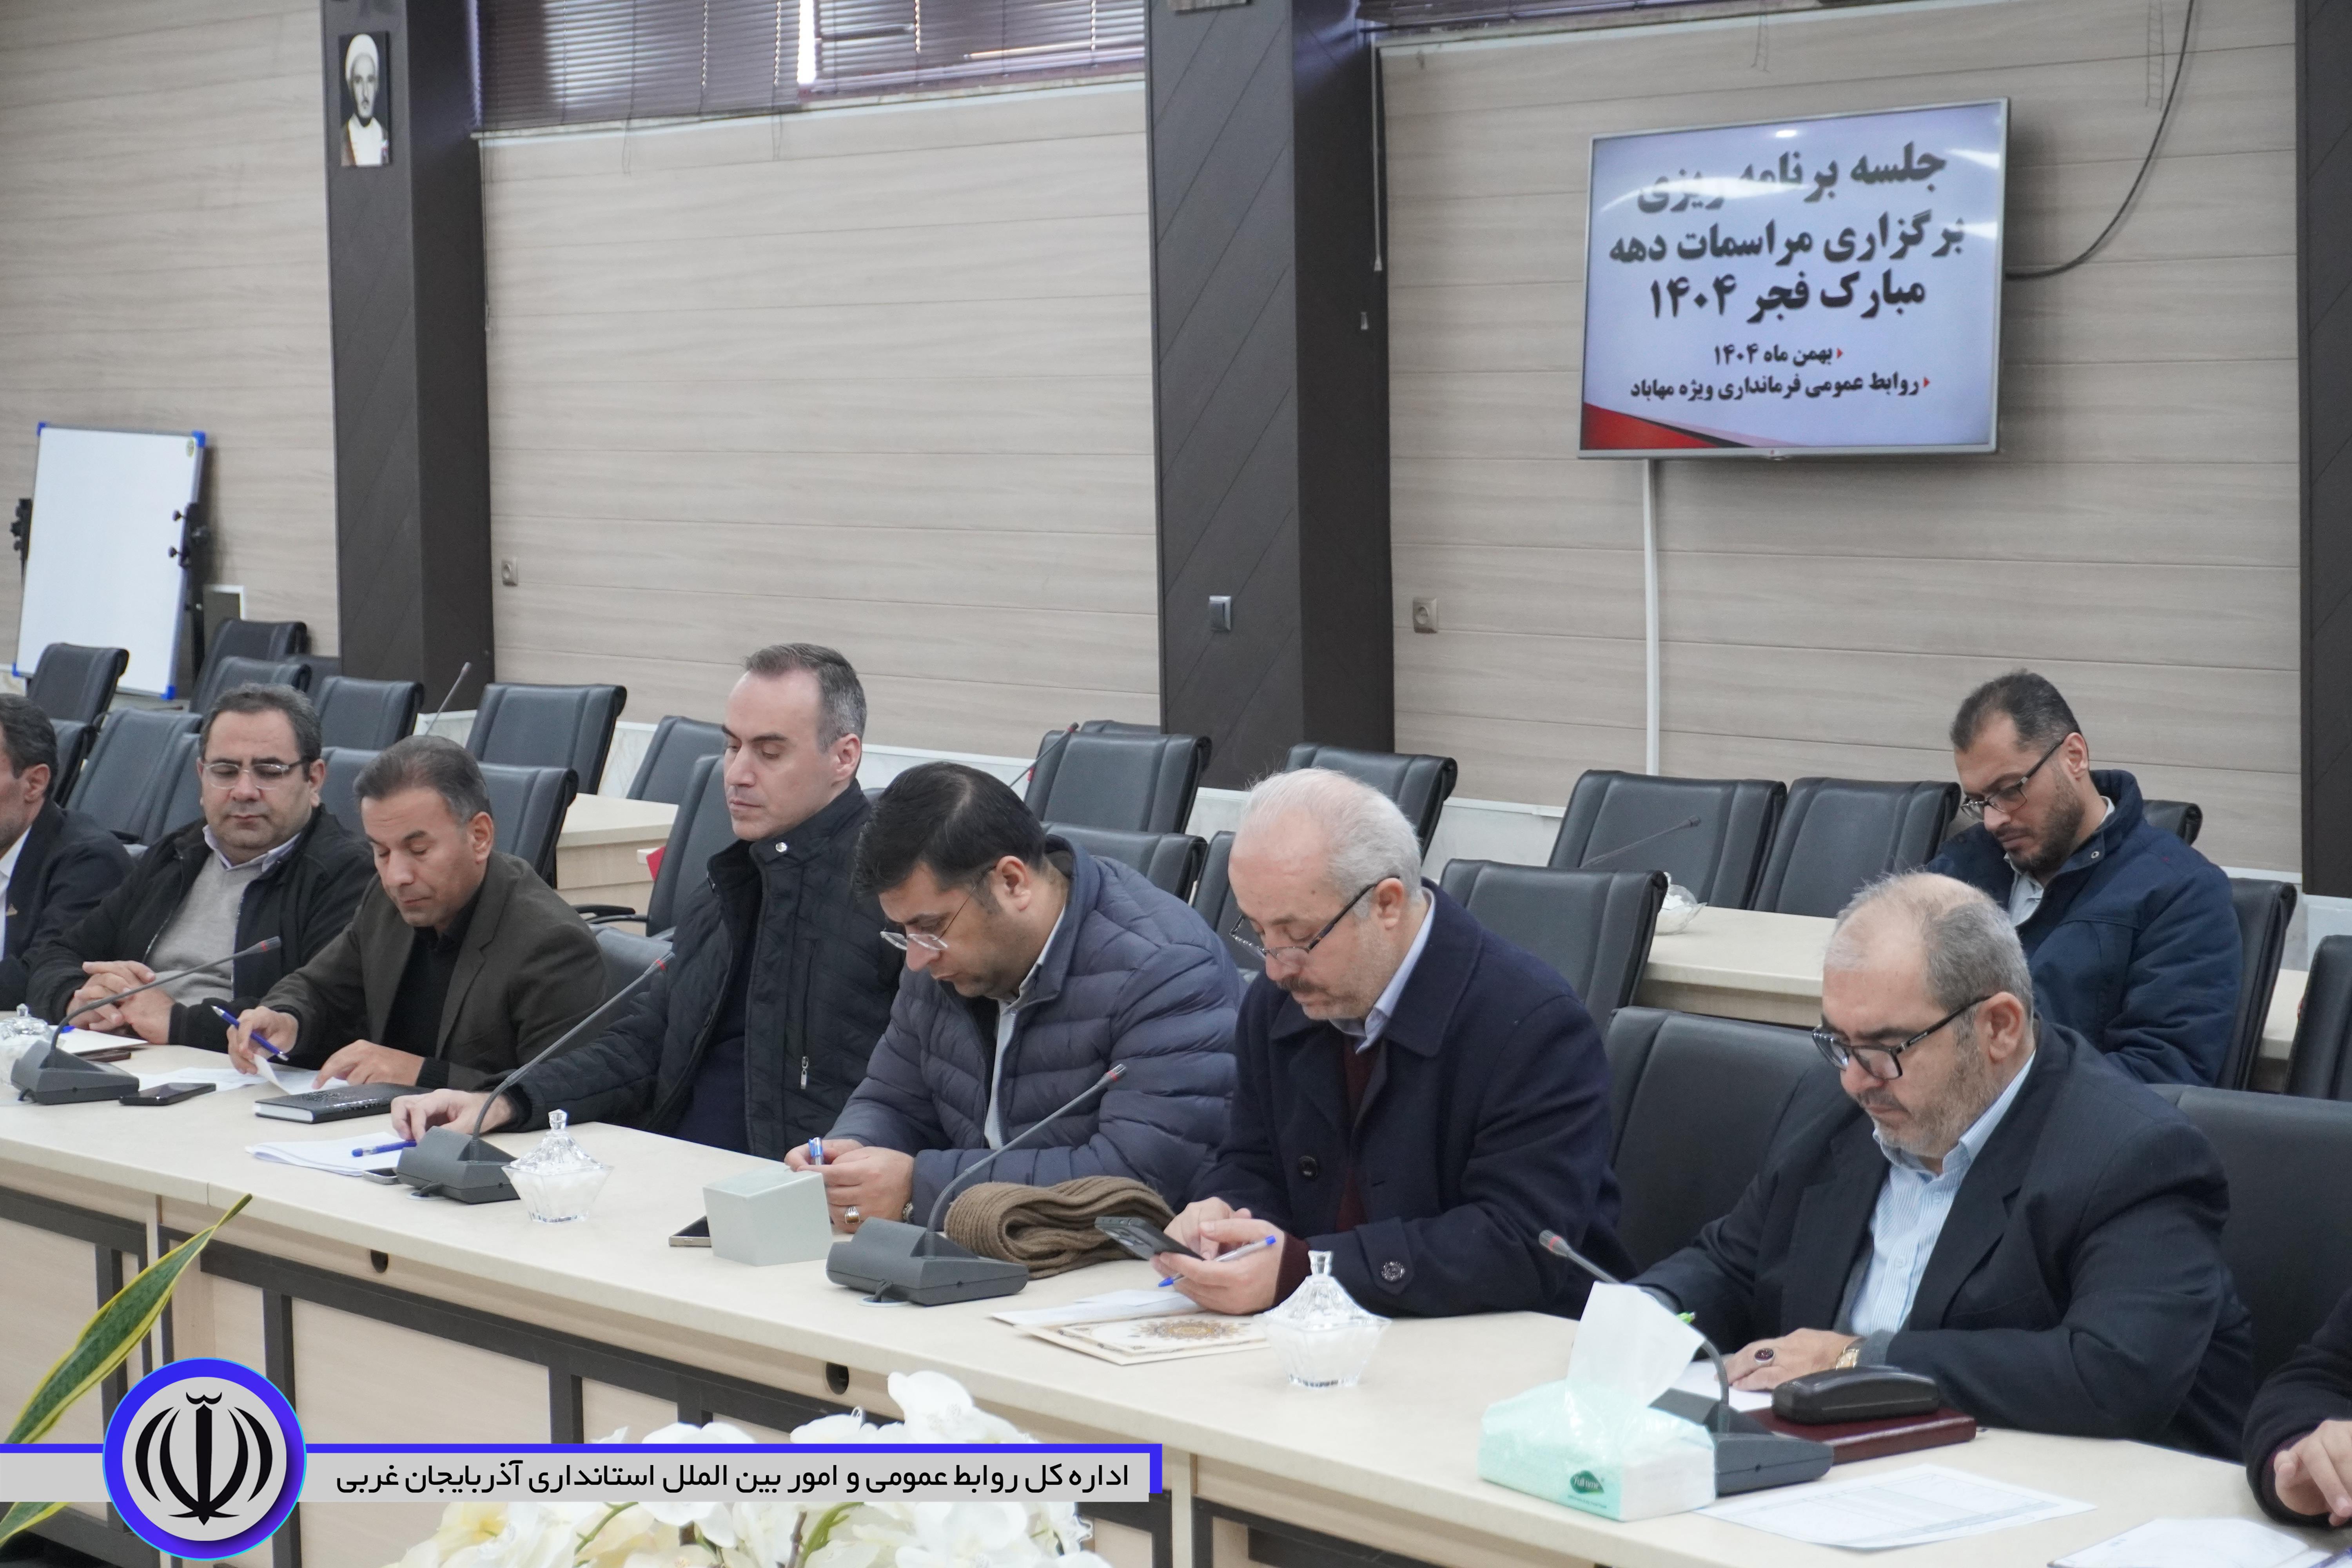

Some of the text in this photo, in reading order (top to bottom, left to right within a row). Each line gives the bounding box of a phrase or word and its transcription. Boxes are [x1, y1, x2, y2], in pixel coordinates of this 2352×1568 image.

[1850, 142, 1947, 193] جلسه
[1609, 209, 1965, 267] برگزاری مراسمات دهه
[1650, 268, 1926, 325] مبارک فجر ۱۴۰۴
[1713, 343, 1833, 368] بهمن ماه ۱۴۰۴
[1630, 371, 1920, 402] روابط عمومی فرمانداری ویژه مهاباد
